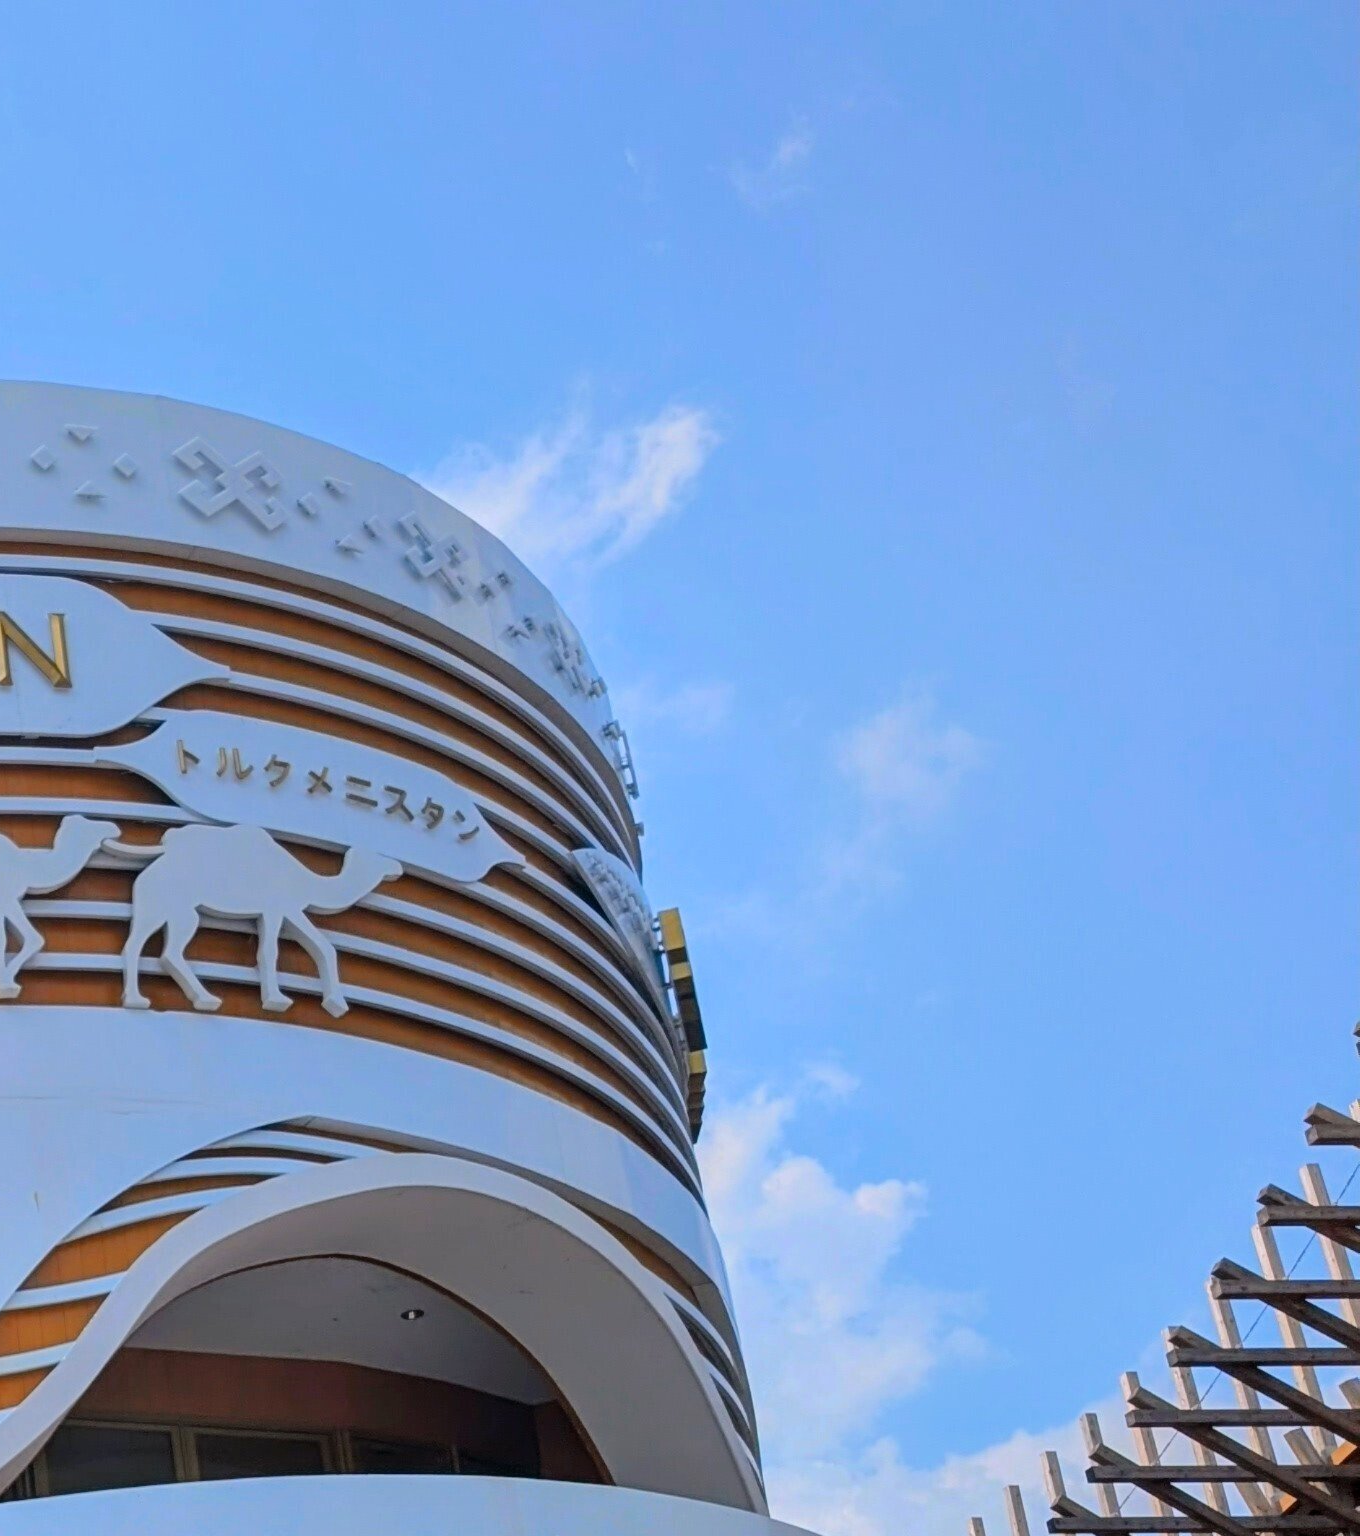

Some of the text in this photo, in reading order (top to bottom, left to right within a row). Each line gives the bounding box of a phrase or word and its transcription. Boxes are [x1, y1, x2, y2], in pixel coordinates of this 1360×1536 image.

[176, 739, 481, 842] トルクメニスタン
